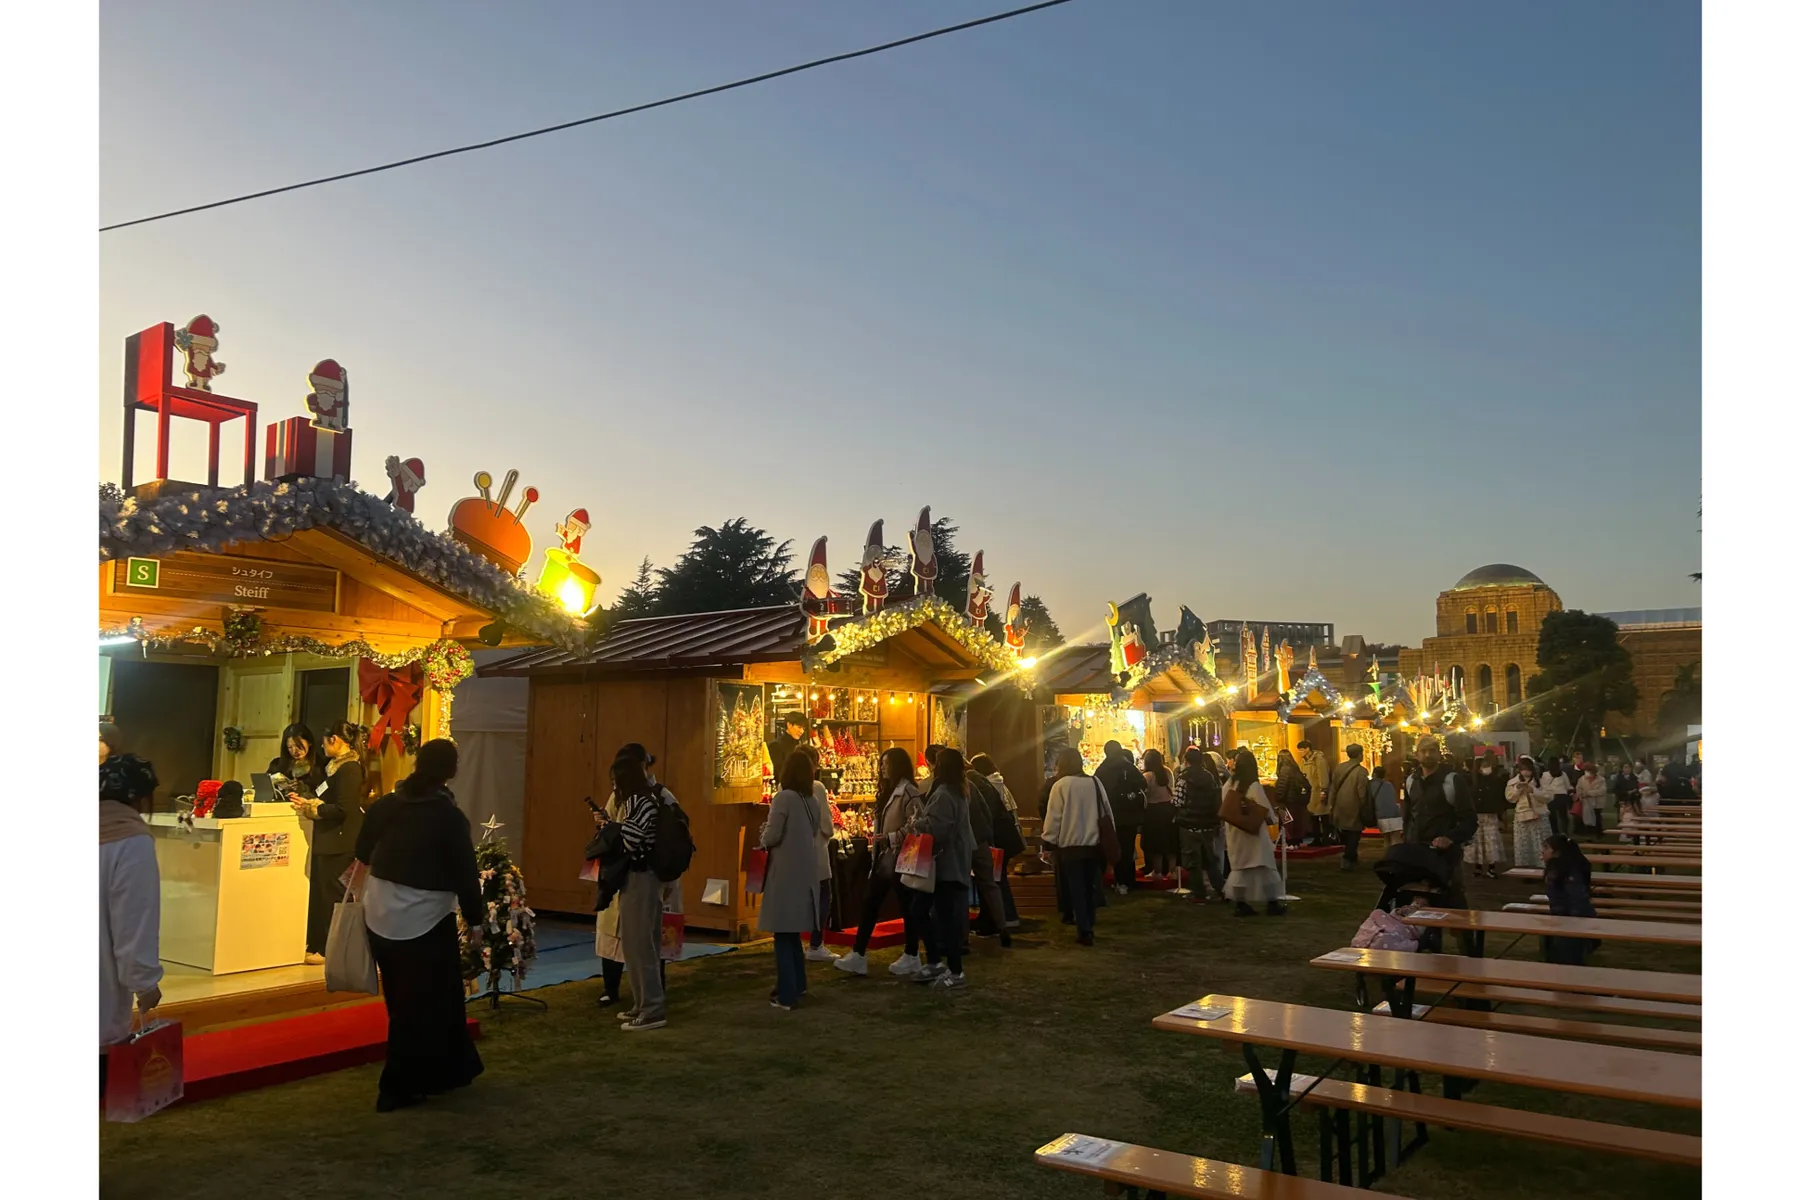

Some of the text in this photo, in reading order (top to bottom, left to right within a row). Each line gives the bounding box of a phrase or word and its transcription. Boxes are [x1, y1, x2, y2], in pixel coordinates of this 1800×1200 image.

[137, 565, 149, 580] S
[232, 566, 274, 579] シュタイフ
[234, 585, 270, 599] Steiff
